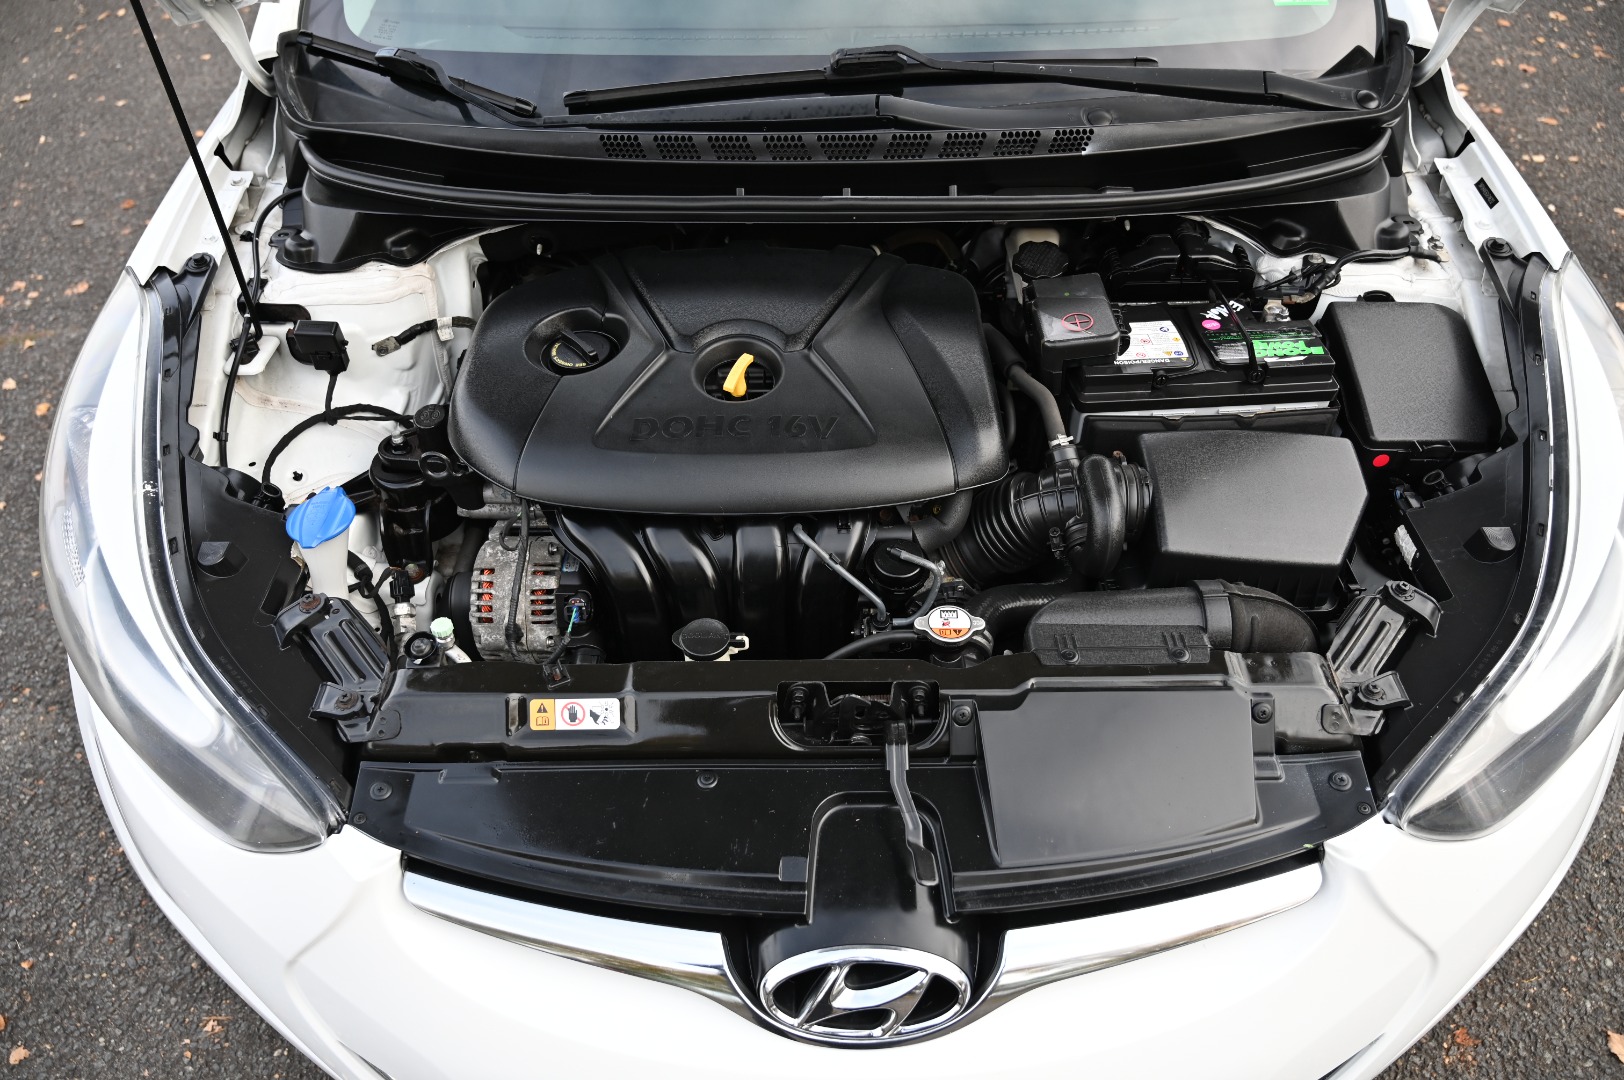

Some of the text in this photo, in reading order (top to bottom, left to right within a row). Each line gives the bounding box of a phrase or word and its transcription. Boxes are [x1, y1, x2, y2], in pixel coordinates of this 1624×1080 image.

[630, 415, 840, 442] DOHC 16V
[682, 632, 729, 640] COOLANT
